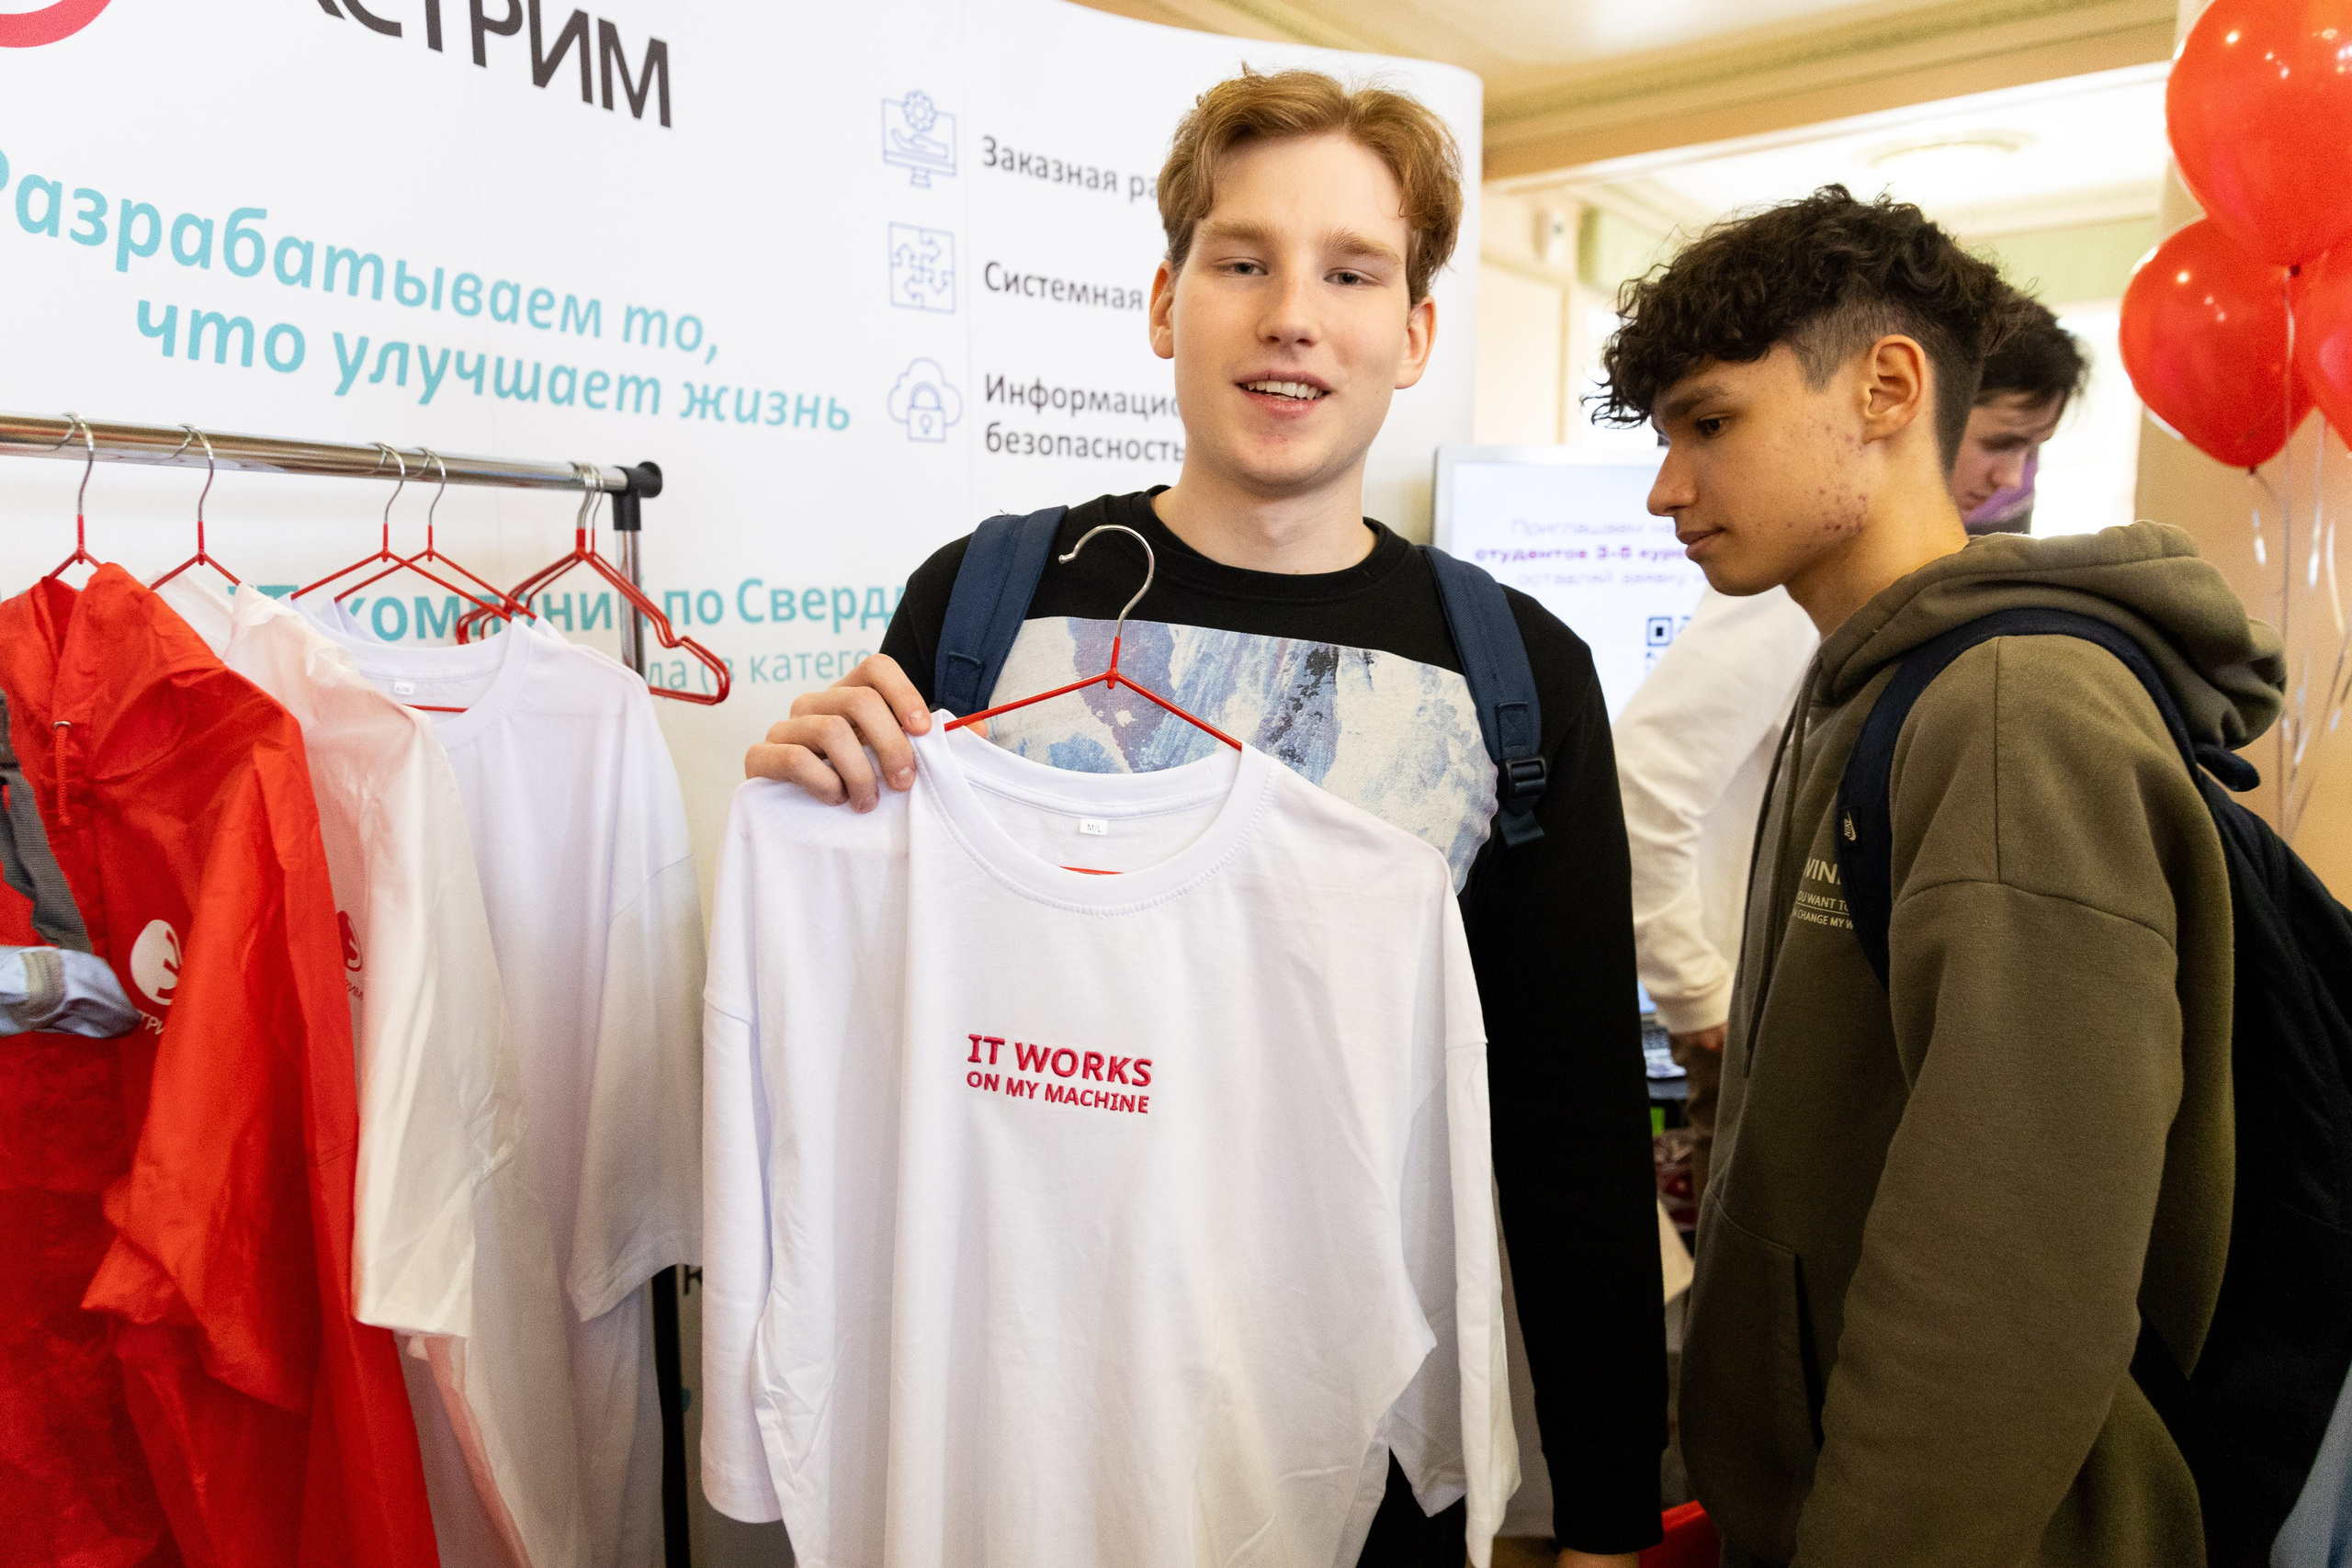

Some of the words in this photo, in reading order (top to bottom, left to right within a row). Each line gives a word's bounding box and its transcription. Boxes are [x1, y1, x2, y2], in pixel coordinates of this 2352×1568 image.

[318, 0, 672, 128] РИМ
[982, 134, 1118, 194] Заказная
[0, 149, 603, 339] азрабатываем
[622, 303, 719, 365] то,
[984, 261, 1143, 311] Системная
[137, 299, 307, 374] что
[332, 331, 662, 415] улучшает
[679, 379, 852, 432] жизнь
[985, 422, 1184, 464] безопасность
[663, 588, 724, 626] по
[1807, 893, 1837, 909] WANT
[1829, 916, 1845, 928] MY
[967, 1033, 1006, 1065] IT
[1014, 1042, 1153, 1087] WORKS
[967, 1070, 1001, 1092] ON
[1005, 1077, 1040, 1100] MY
[1044, 1083, 1149, 1114] MACHINE
